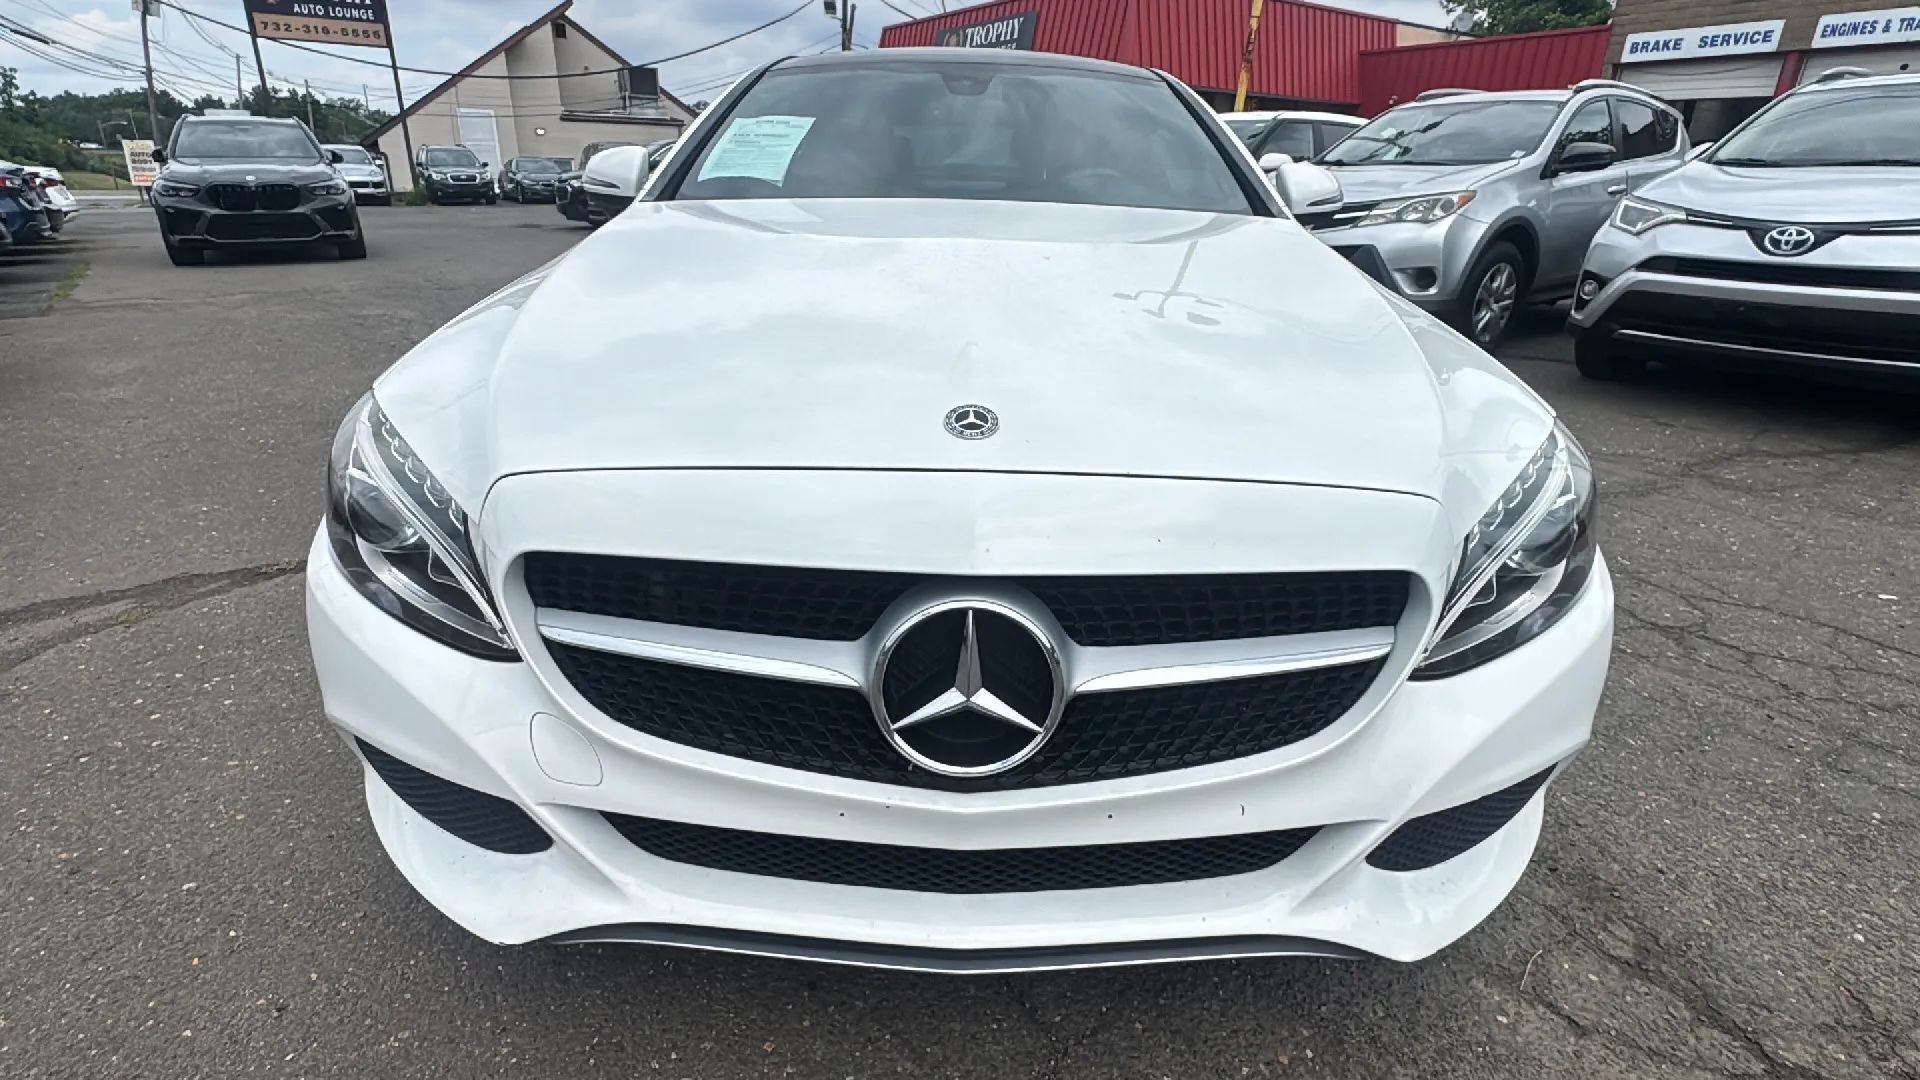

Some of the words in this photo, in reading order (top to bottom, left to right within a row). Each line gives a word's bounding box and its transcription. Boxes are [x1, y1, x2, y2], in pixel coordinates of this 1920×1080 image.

[293, 3, 324, 15] AUTO
[328, 6, 375, 20] LOUNGE
[965, 17, 1025, 49] TROPHY
[1819, 19, 1879, 39] ENGINES
[1881, 18, 1893, 34] &
[1629, 37, 1684, 54] BRAKE
[1697, 29, 1775, 49] SERVICE
